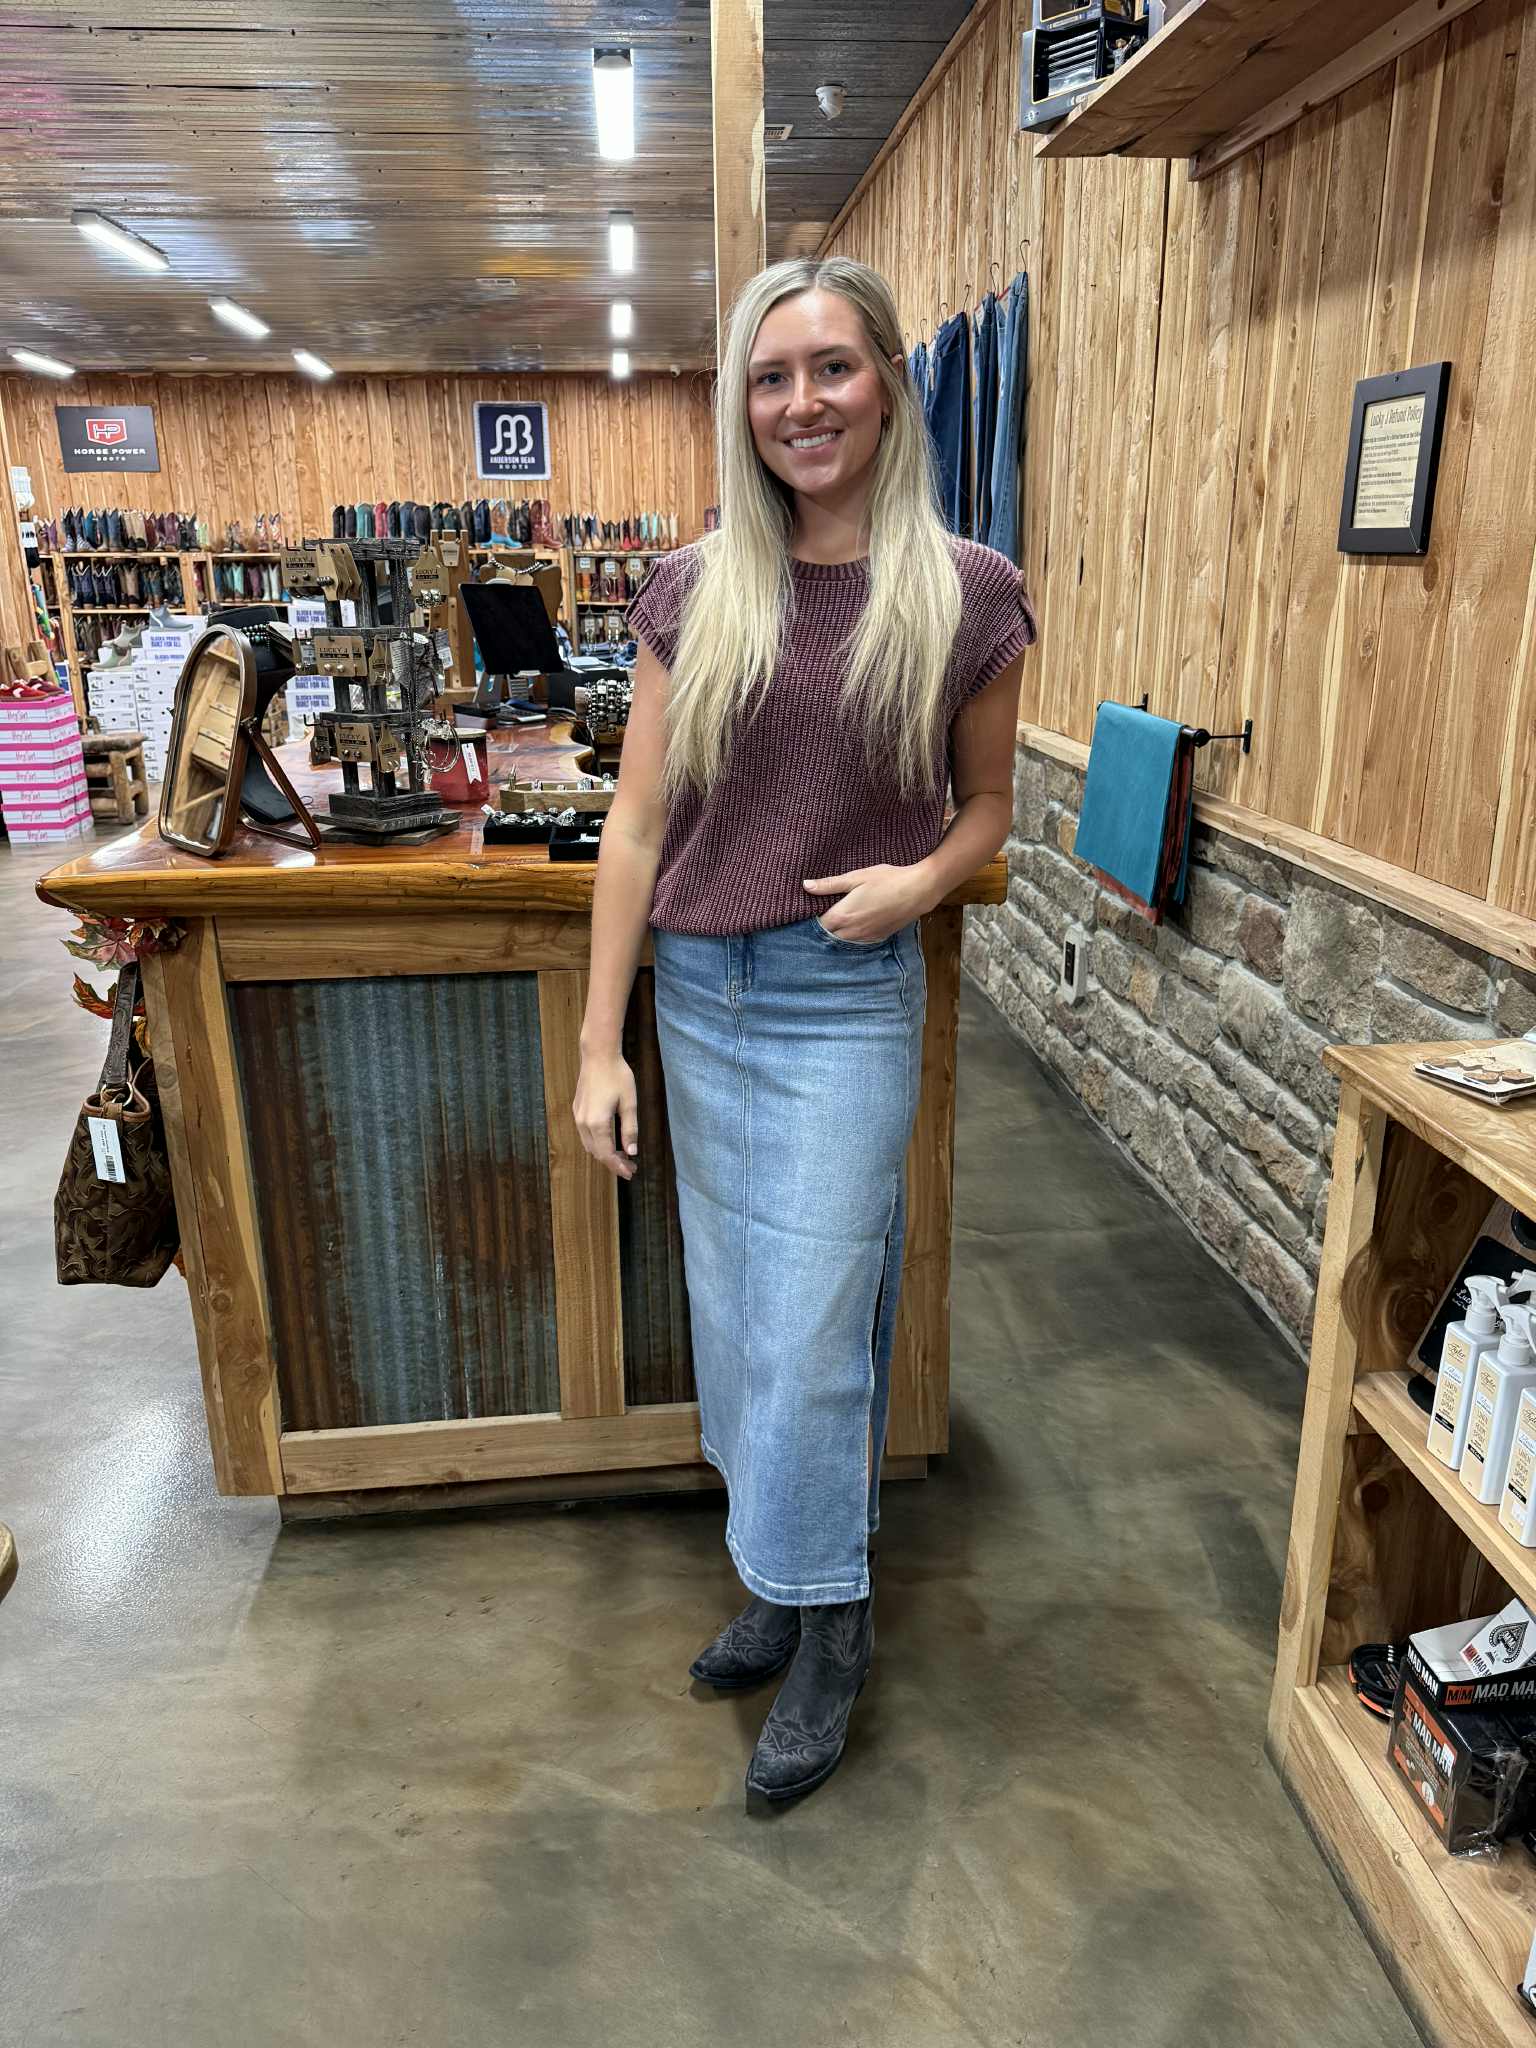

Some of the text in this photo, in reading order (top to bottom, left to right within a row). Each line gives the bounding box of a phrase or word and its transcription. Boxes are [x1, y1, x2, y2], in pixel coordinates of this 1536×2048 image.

[1407, 1644, 1421, 1672] MAD
[1421, 1666, 1438, 1697] MAN
[1474, 1682, 1509, 1699] MAD
[1511, 1680, 1536, 1695] MA
[1413, 1711, 1432, 1747] MAD
[1432, 1739, 1453, 1778] MAN
